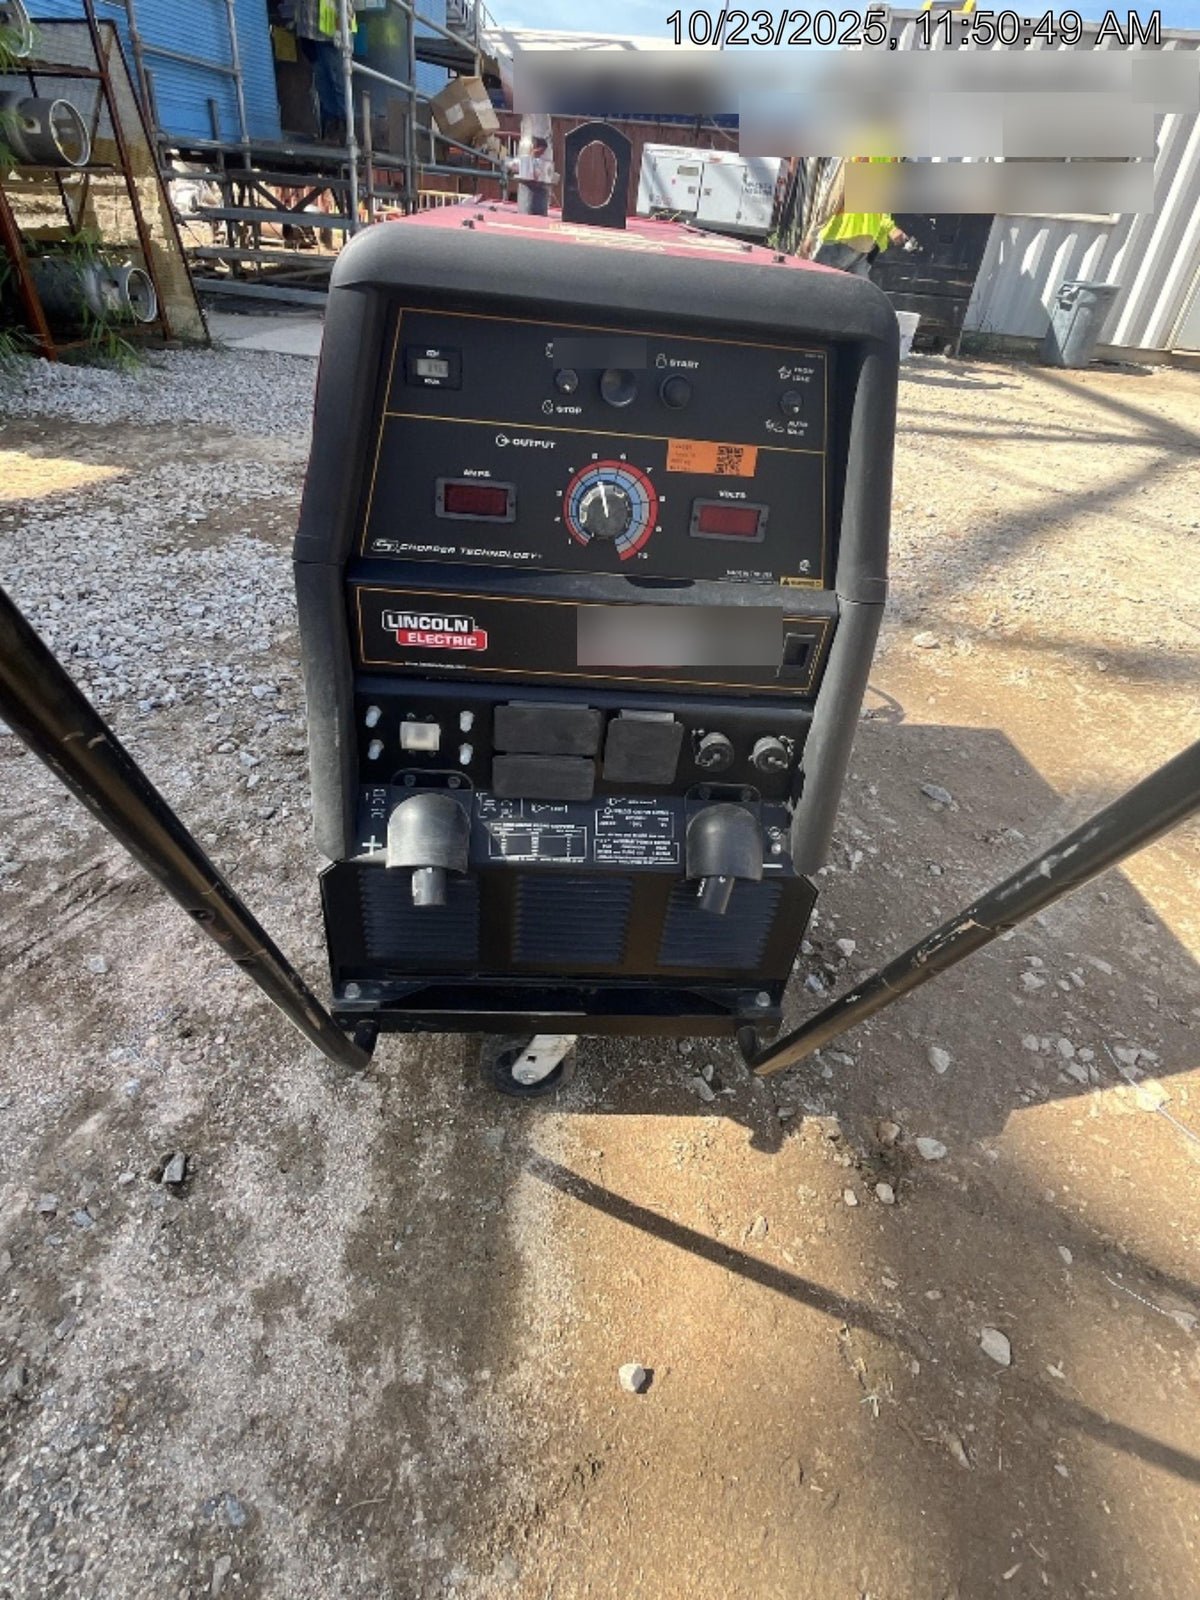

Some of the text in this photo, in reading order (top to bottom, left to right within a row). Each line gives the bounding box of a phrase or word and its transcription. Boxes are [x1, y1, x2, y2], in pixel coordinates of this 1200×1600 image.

[669, 359, 700, 369] START
[556, 405, 583, 414] STOP
[512, 438, 557, 449] OUTPUT
[463, 468, 491, 477] AMPS
[718, 490, 747, 499] VOLTS
[400, 542, 456, 554] CHOPPER
[460, 546, 538, 559] TECHNOLOGY
[386, 614, 469, 632] LINCOLN
[407, 632, 478, 647] ELECTRIC
